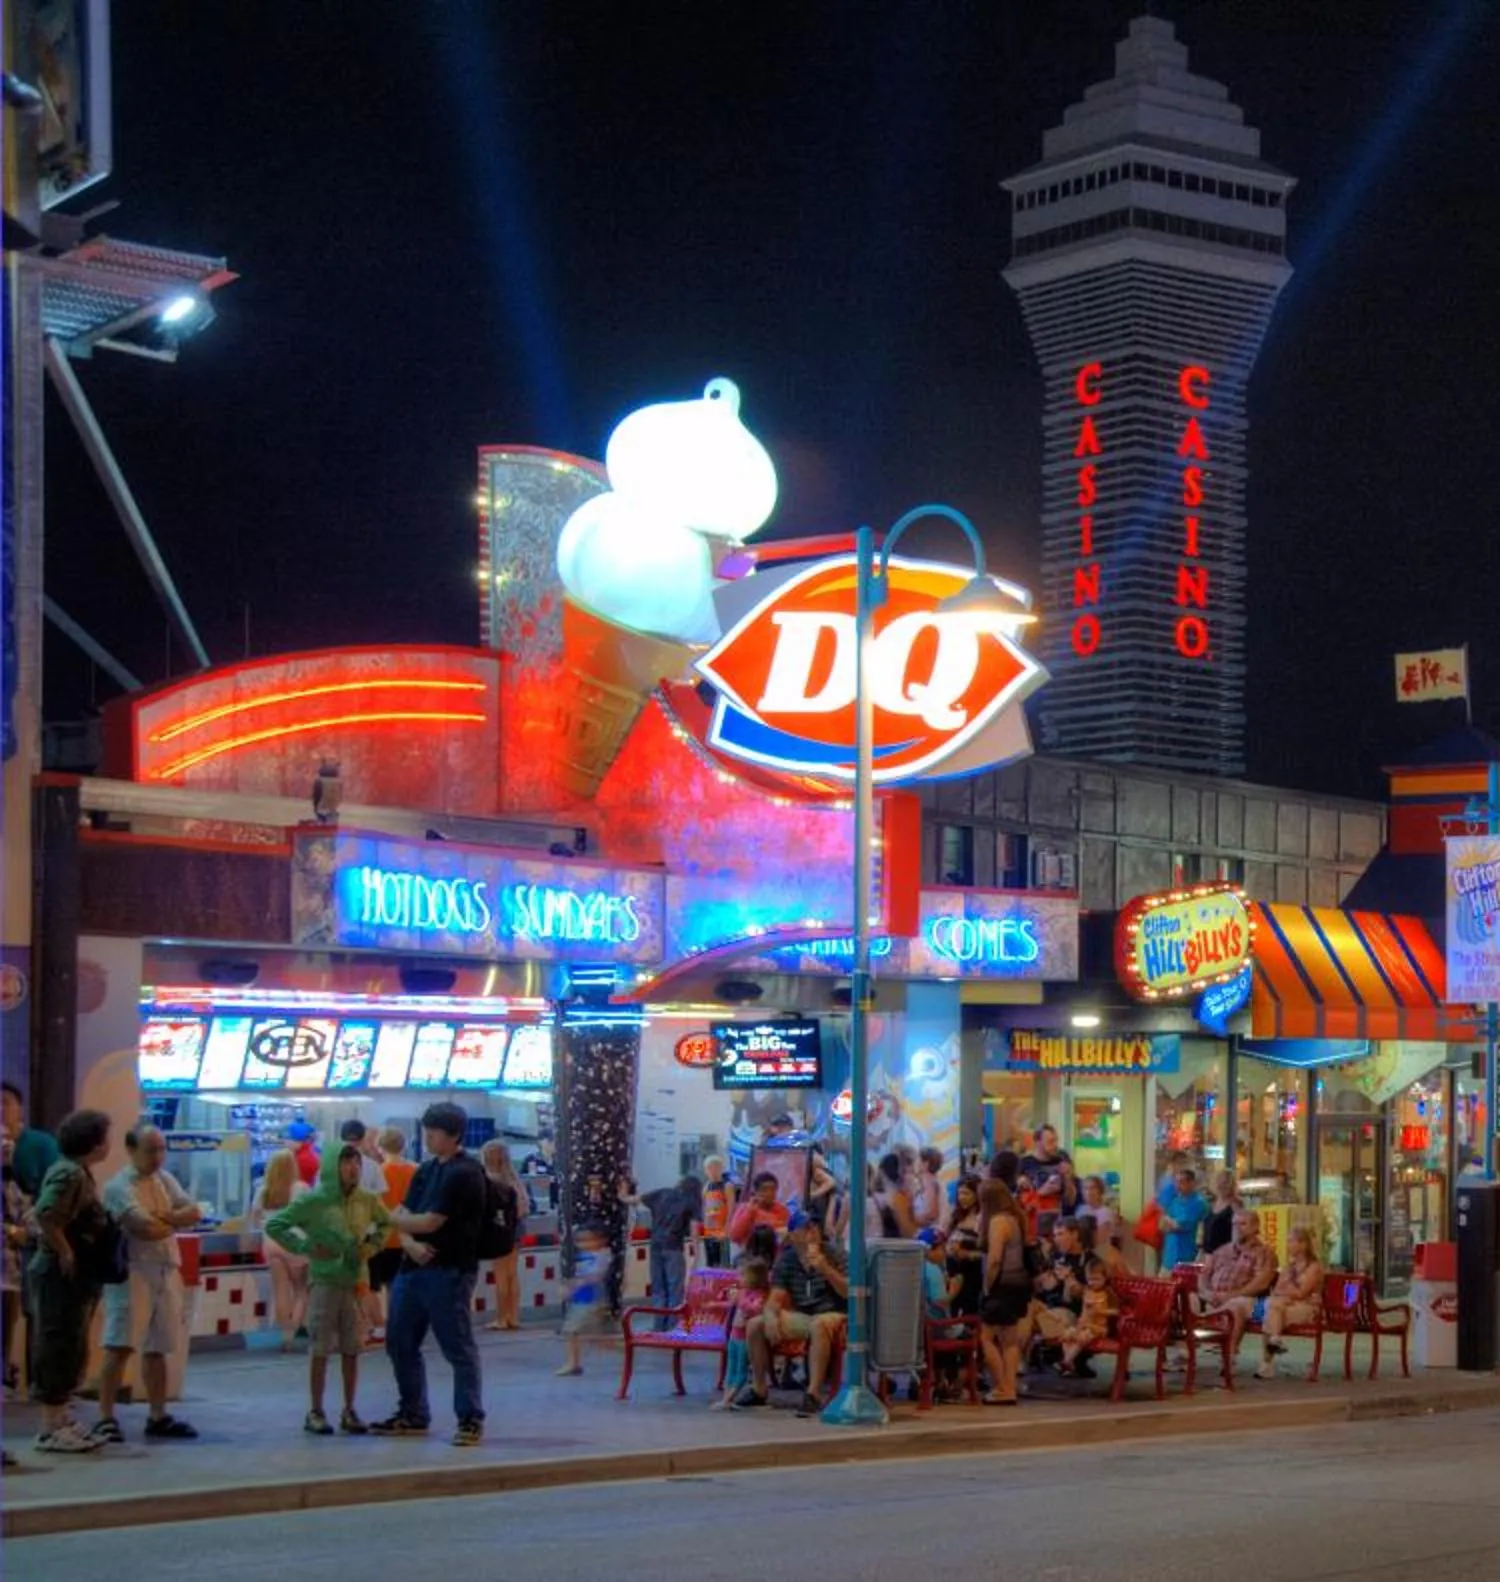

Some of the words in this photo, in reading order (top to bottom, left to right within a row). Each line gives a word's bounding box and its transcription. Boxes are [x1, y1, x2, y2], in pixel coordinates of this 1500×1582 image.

[1070, 360, 1103, 657] CASINO
[1175, 365, 1210, 658] CASINO
[757, 610, 981, 731] DQ
[362, 866, 490, 932] HOTDOGS
[513, 885, 640, 943] SUNDAES
[1470, 884, 1500, 919] Hill
[932, 917, 1038, 961] CONES
[1143, 915, 1181, 939] Clifton
[253, 1027, 330, 1064] OPEN
[748, 1036, 782, 1051] BIG
[1014, 1031, 1040, 1051] THE
